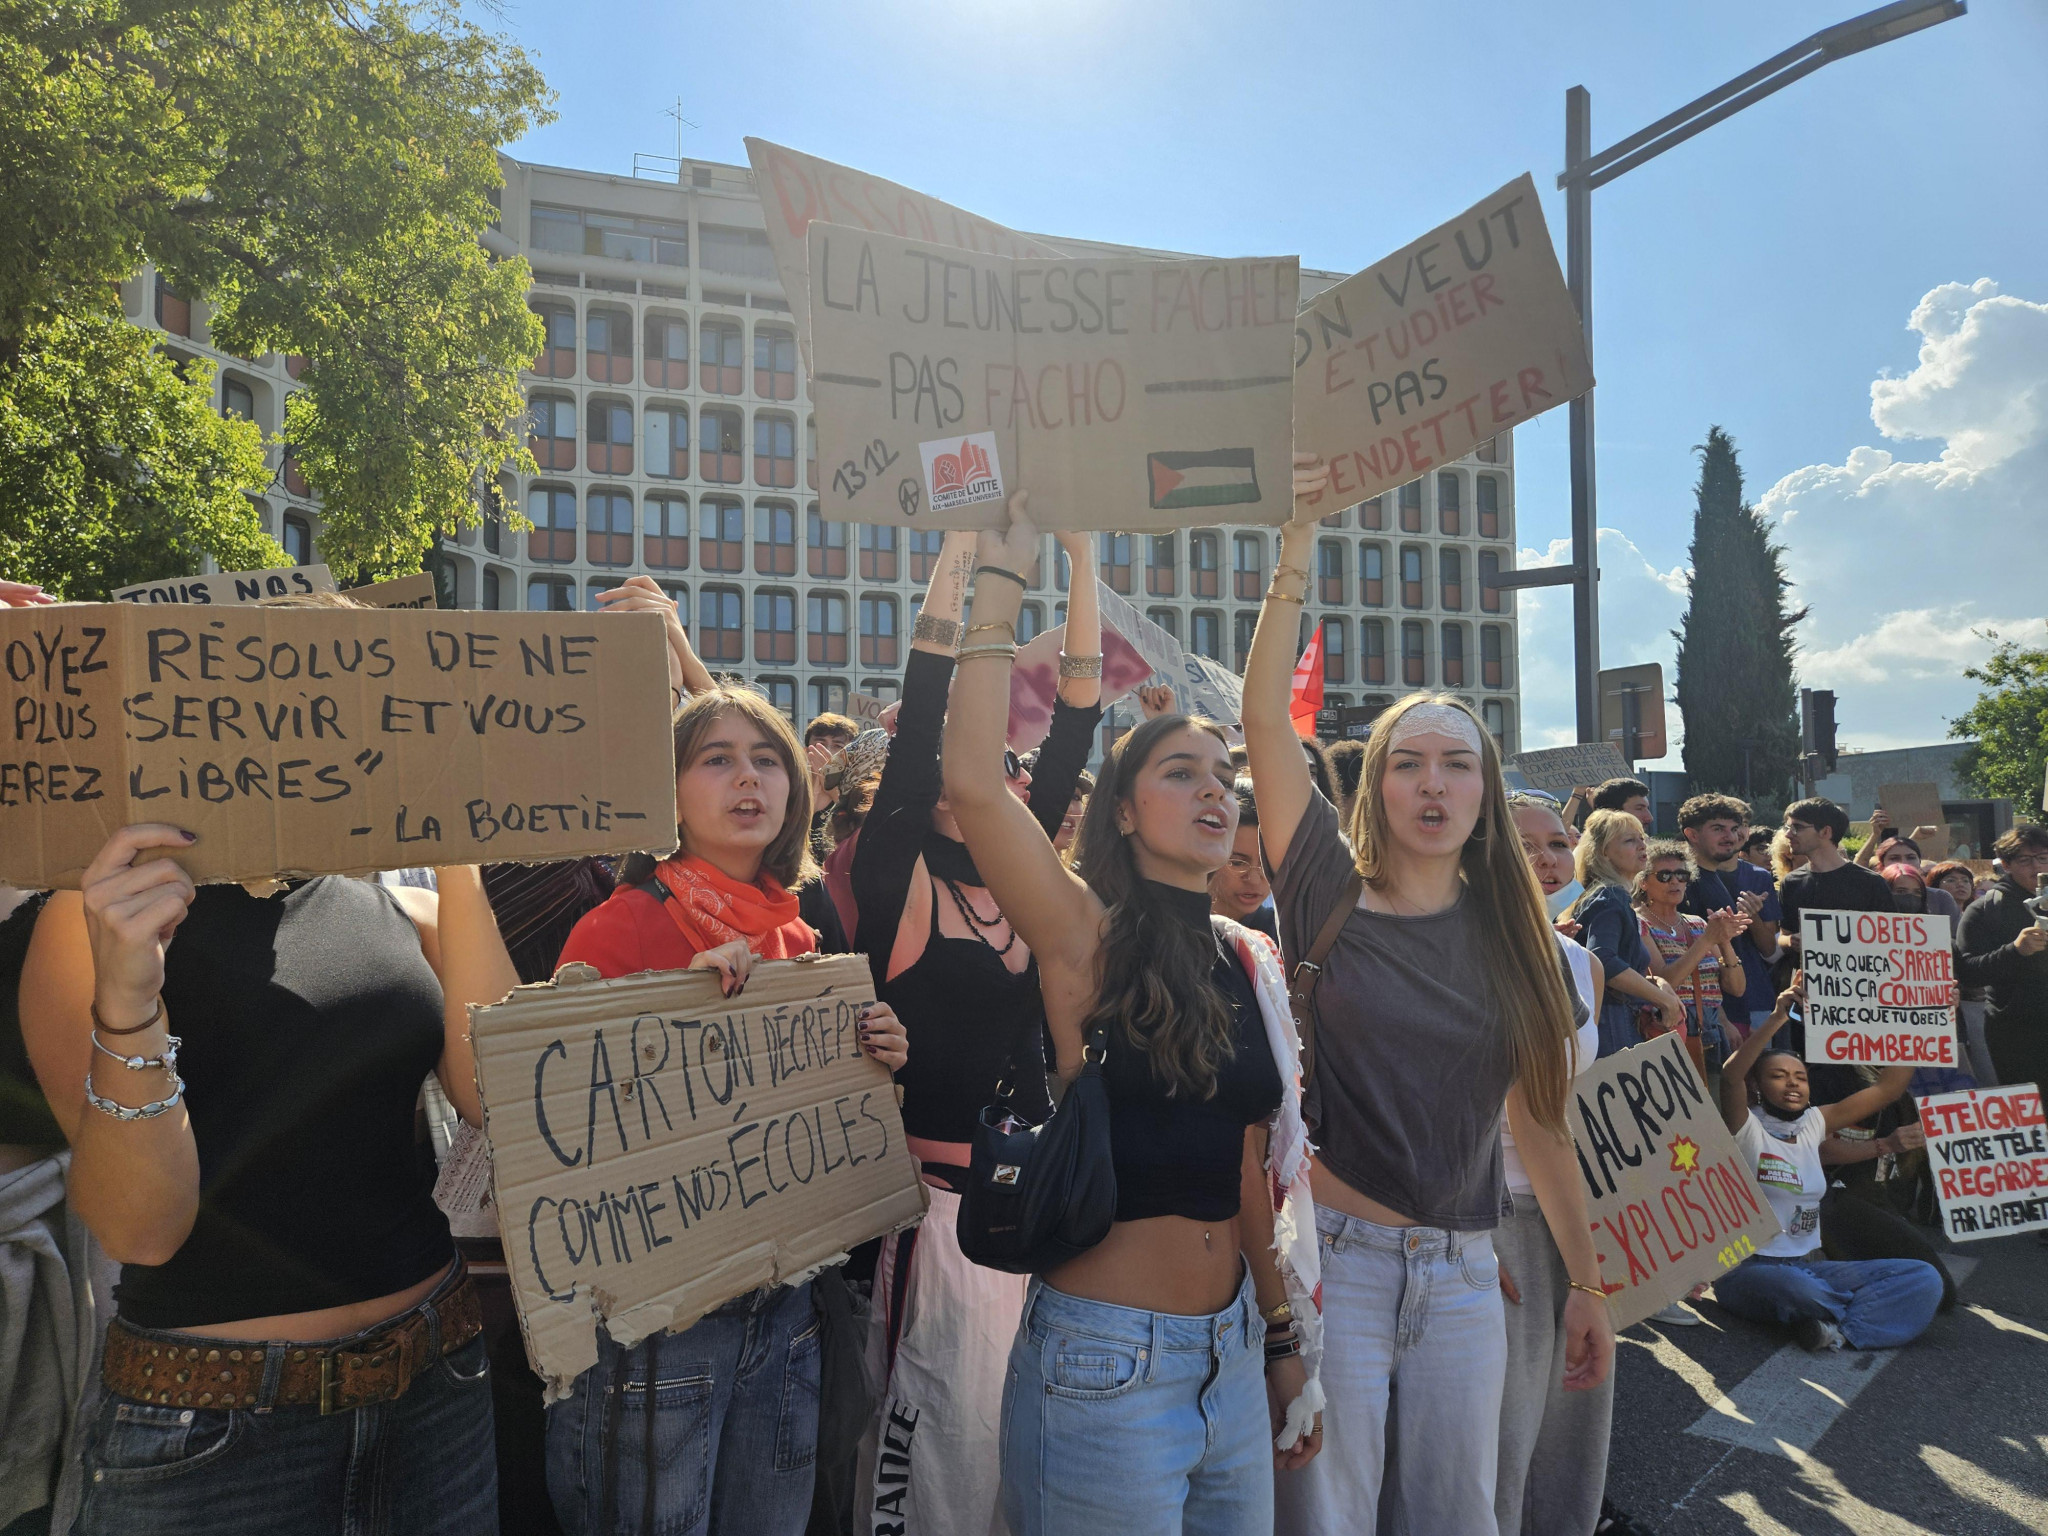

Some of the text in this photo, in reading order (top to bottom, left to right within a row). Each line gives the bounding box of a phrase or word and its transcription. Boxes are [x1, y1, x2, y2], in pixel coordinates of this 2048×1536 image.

[1378, 196, 1523, 308] VEUT
[822, 237, 880, 317] LA
[902, 249, 1136, 336] JEUNESSE
[889, 351, 1126, 431] PAS FACHO
[1367, 358, 1448, 425] PAS
[932, 497, 973, 511] AIX-MARSEILLE
[958, 489, 966, 497] DE
[966, 479, 999, 496] LUTTE
[6, 621, 599, 696] OYEZ RÉSOLUS DE NE
[15, 696, 98, 744] PLUS
[381, 695, 453, 734] ET
[396, 805, 442, 843] LA
[1804, 913, 1852, 944] TU
[1804, 950, 1843, 973] POUR
[1855, 978, 1877, 1002] ÇA
[1810, 1004, 1856, 1026] PARCE
[1858, 1006, 1889, 1024] QUE
[1891, 1011, 1907, 1023] TU
[1825, 1030, 1954, 1064] GAMBERGE
[534, 1011, 755, 1169] CARTON
[1935, 1136, 1995, 1165] VOTRE
[527, 1181, 673, 1303] COMME
[727, 1093, 888, 1209] ÉCOLES
[1950, 1206, 1980, 1234] PAR
[1979, 1204, 2002, 1230] LA
